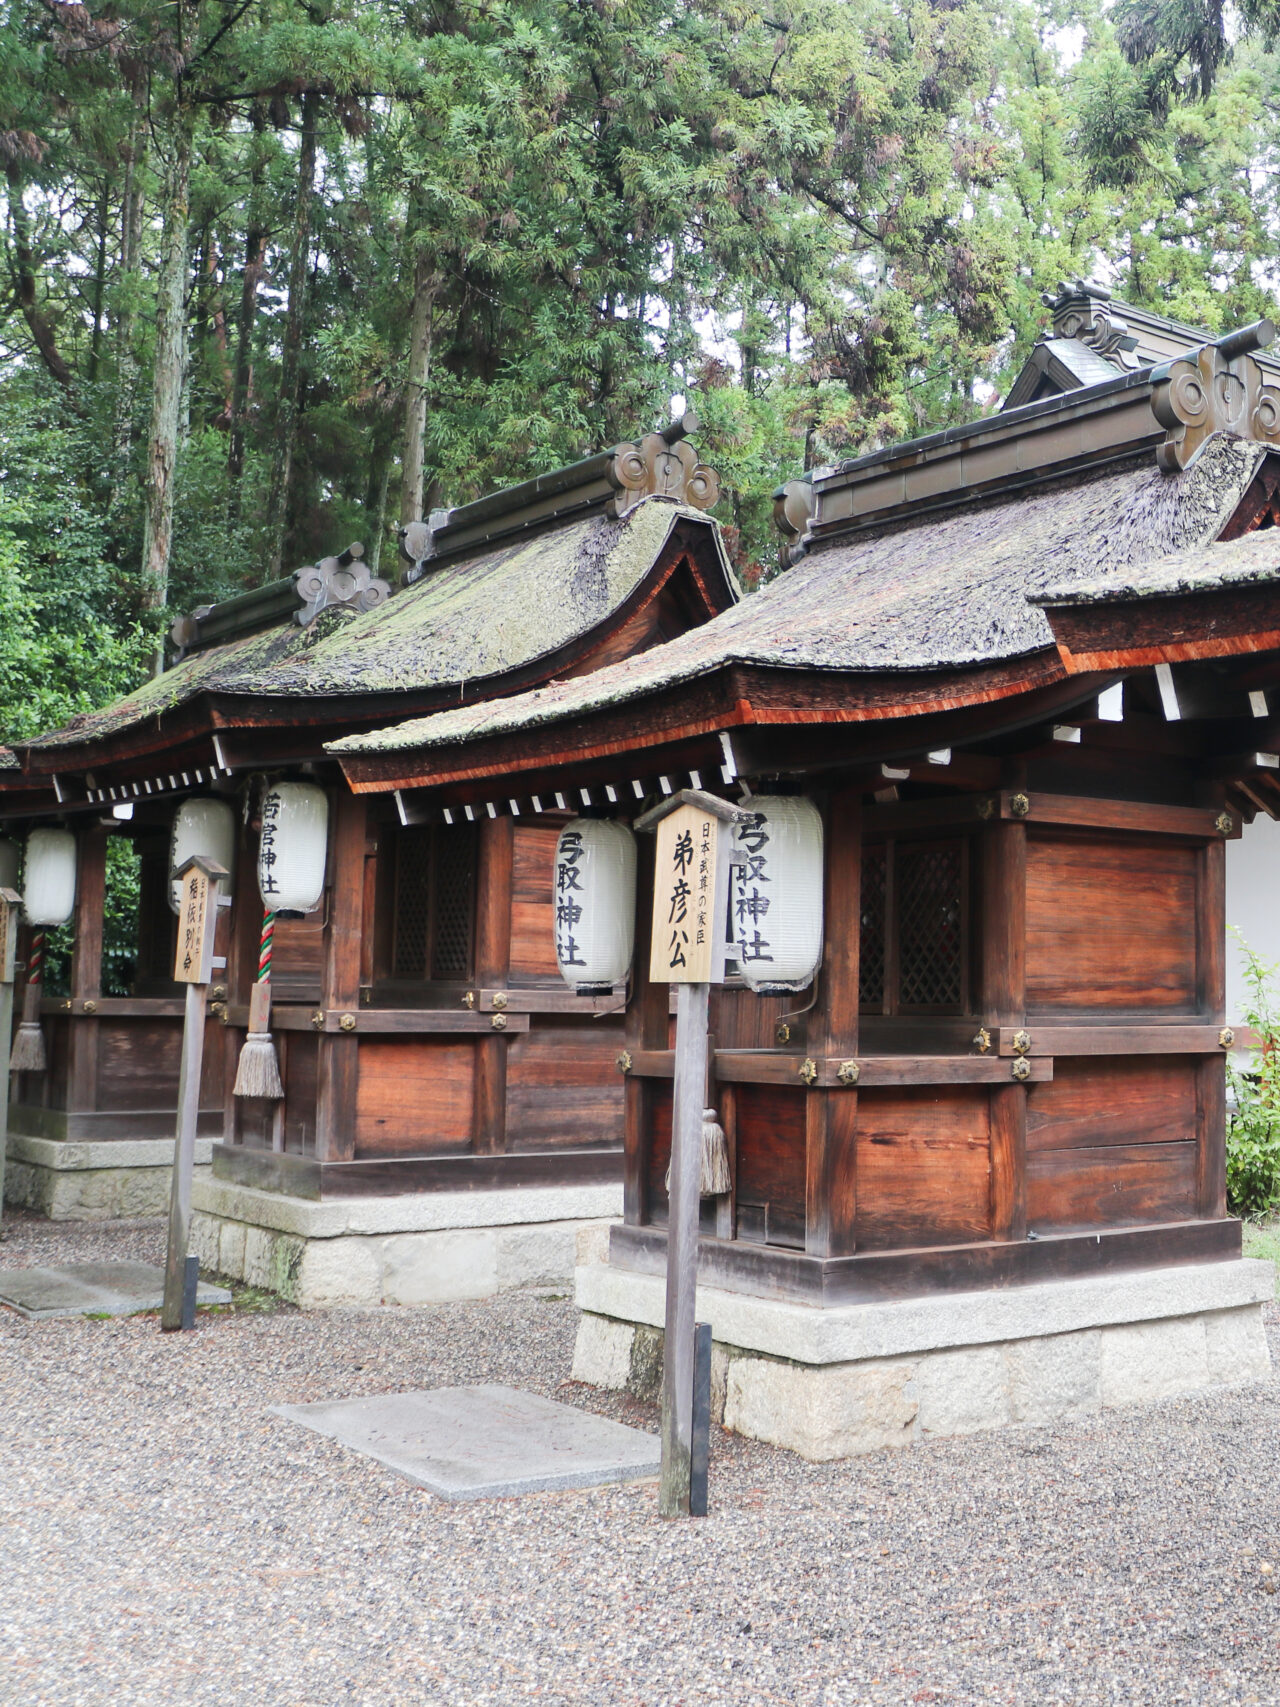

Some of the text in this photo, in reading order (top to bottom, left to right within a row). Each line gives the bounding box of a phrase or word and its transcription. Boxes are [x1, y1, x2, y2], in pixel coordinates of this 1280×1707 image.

[557, 832, 587, 967] 弓取神社
[668, 829, 694, 968] 弟彦公
[696, 822, 711, 945] 日本武尊の家臣
[736, 813, 774, 965] 弓取神社
